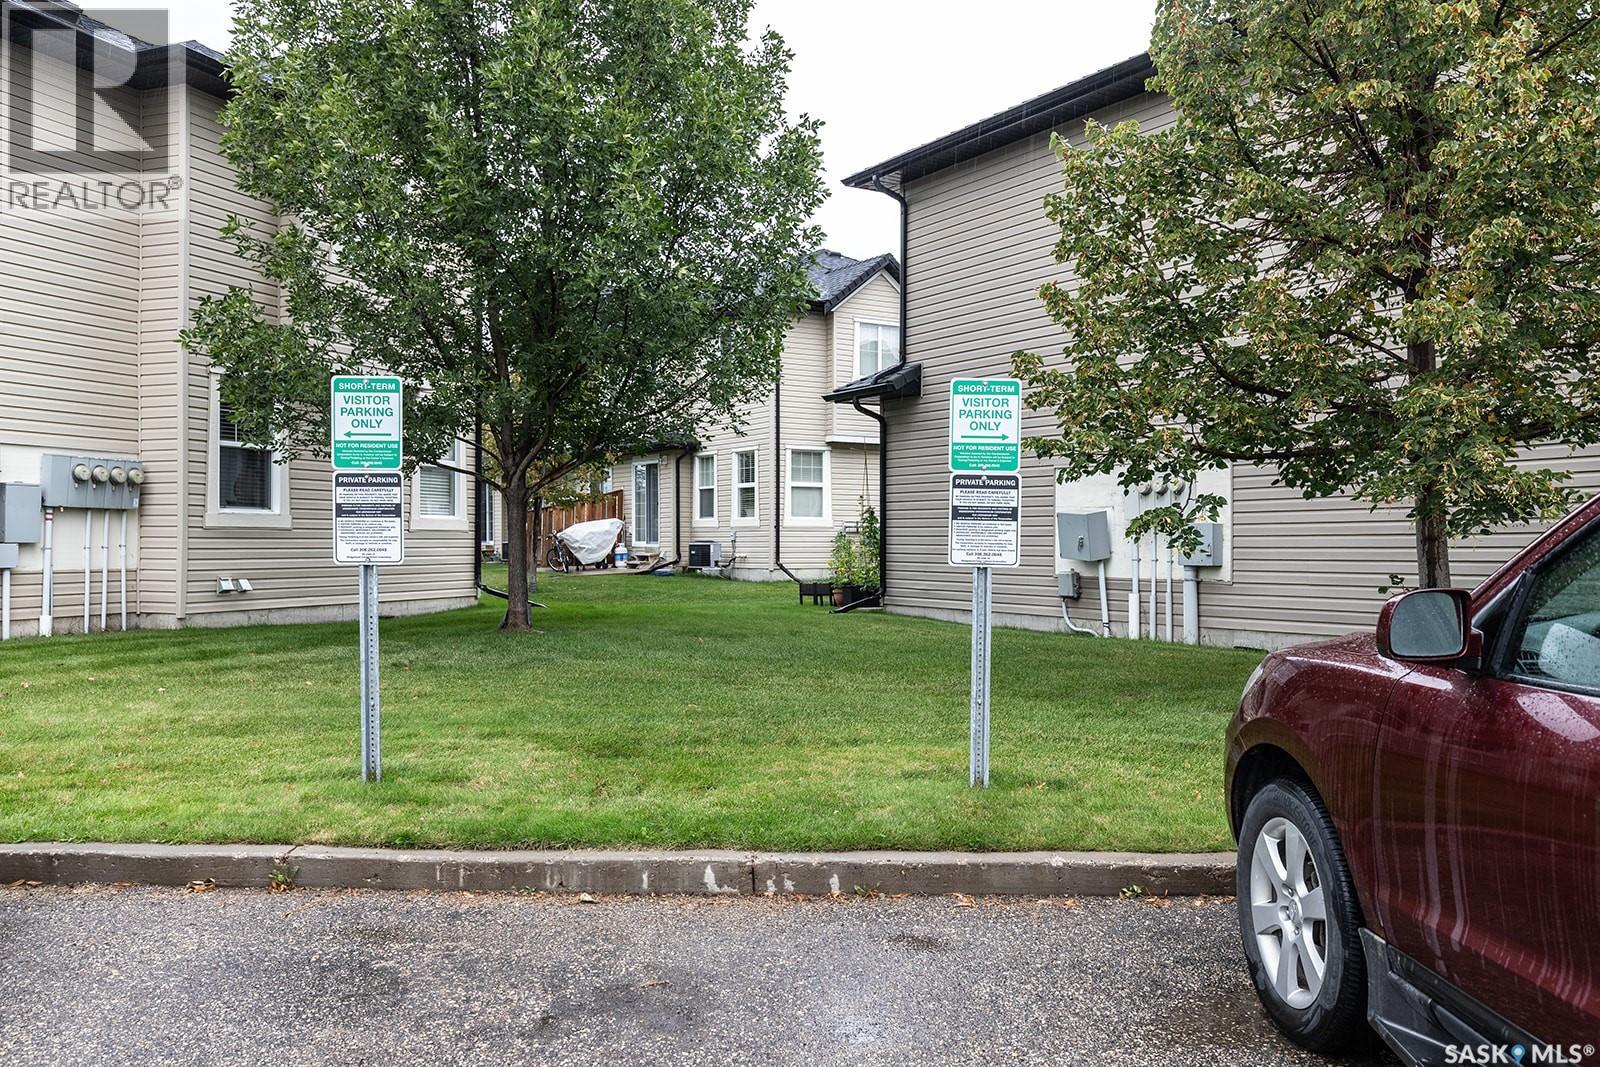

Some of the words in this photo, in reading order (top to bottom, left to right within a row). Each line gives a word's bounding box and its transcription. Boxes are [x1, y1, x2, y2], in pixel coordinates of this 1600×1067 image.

[343, 395, 391, 405] VISITOR
[962, 398, 1009, 407] VISITOR
[340, 407, 394, 416] PARKING
[959, 410, 1012, 419] PARKING
[351, 419, 383, 428] ONLY
[969, 421, 1002, 431] ONLY
